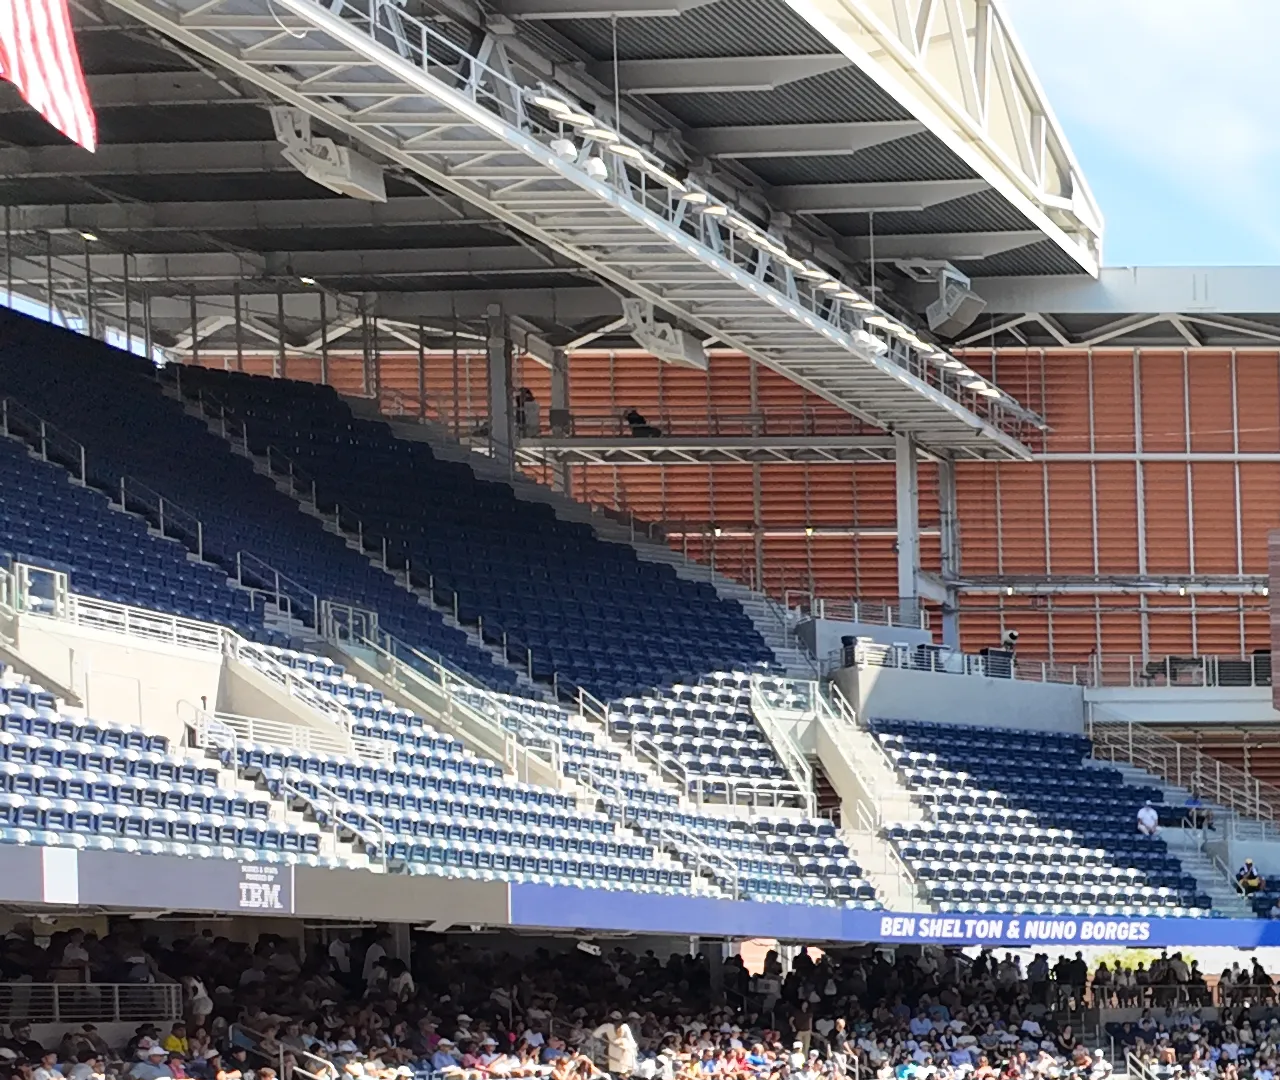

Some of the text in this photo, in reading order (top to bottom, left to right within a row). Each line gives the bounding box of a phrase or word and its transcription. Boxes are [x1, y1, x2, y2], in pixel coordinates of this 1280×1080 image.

[239, 882, 284, 908] IBM
[880, 917, 1151, 941] BEN SHELTON & NUNO BORGES
